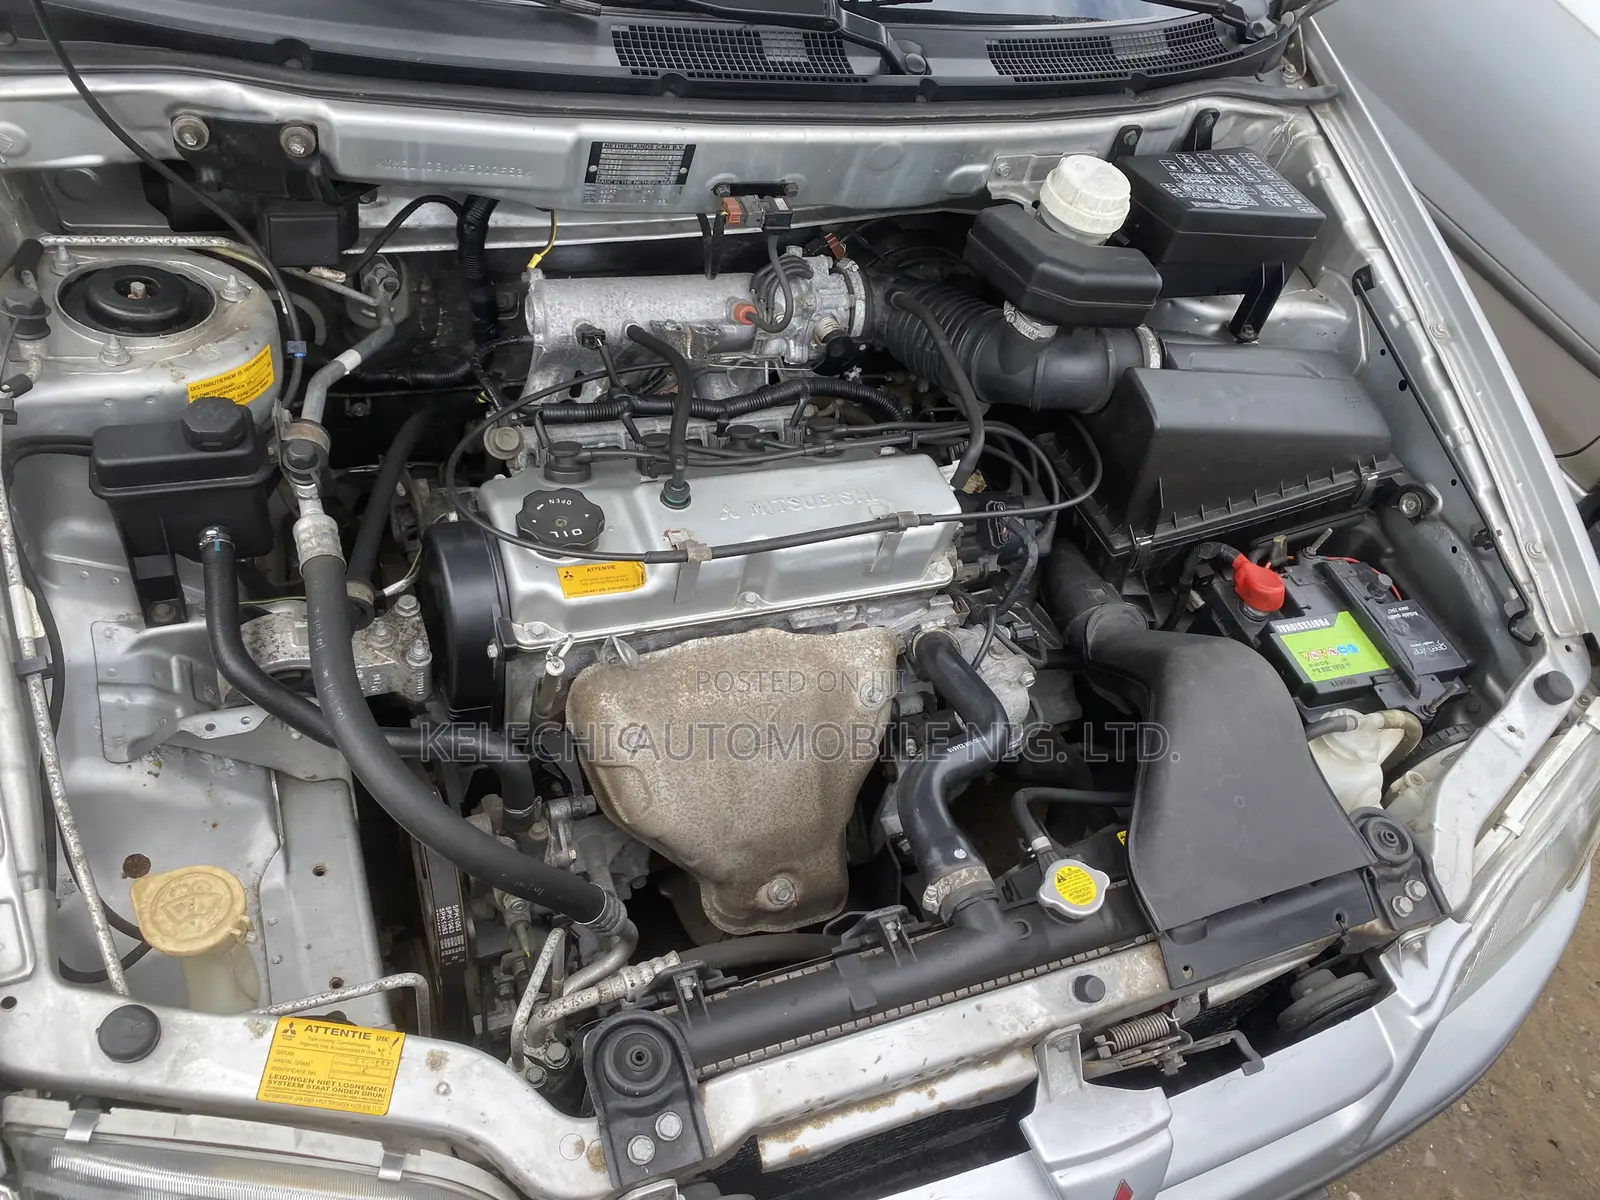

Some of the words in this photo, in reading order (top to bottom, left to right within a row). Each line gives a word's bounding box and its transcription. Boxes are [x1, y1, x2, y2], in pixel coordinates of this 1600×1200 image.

[548, 498, 572, 506] OPEN
[746, 486, 878, 516] MITSUBISHI
[549, 528, 583, 538] OIL
[587, 564, 616, 573] ATTENTIE
[1276, 618, 1330, 632] PROFESSIONAL
[304, 1024, 372, 1041] ATTENTIE
[267, 1079, 304, 1088] SYSTEEM
[332, 1087, 360, 1095] ONDER
[361, 1091, 386, 1099] DRUK!
[269, 1074, 315, 1084] LEIDINGEN
[316, 1079, 336, 1087] NIET
[338, 1082, 387, 1093] LOSNEMEN!
